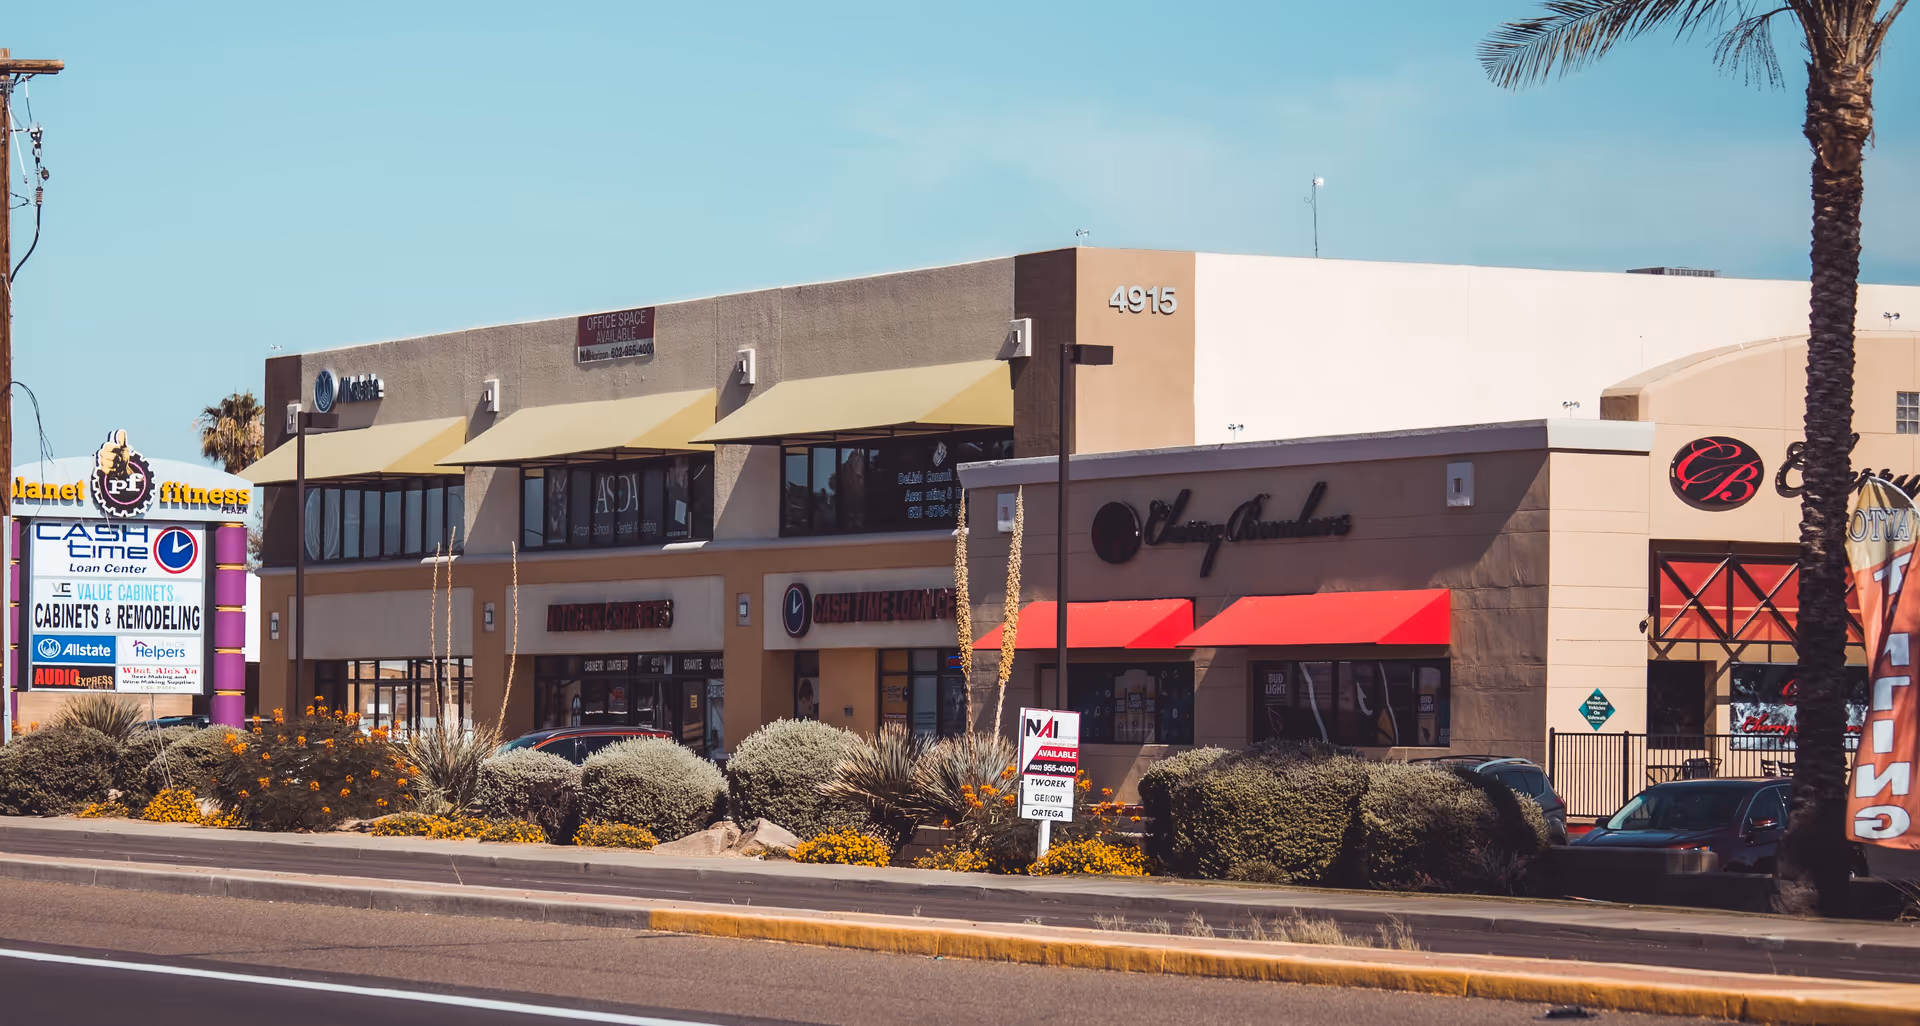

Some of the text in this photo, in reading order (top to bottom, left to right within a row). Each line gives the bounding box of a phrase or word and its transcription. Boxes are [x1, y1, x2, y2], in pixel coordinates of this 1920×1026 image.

[1108, 285, 1178, 316] 4915
[586, 310, 646, 330] OFFICE SPACE
[596, 327, 636, 344] AVAILABLE
[108, 473, 144, 494] pf
[160, 481, 251, 505] fitness
[221, 506, 248, 515] PLAZA
[36, 523, 149, 543] CASH
[67, 540, 148, 560] time
[69, 563, 147, 574] Loan Center
[77, 583, 112, 601] VALUE
[118, 584, 174, 602] CABINETS
[813, 593, 851, 623] CASH
[853, 590, 889, 622] TIME
[34, 603, 200, 631] CABINETS & REMODELING
[62, 643, 111, 657] Allstate
[135, 645, 186, 660] Helpers
[684, 658, 703, 670] GRANITE
[34, 668, 113, 687] AUDIO EXPRESS
[1268, 673, 1284, 684] BUD
[1265, 684, 1287, 695] LIGHT
[1025, 715, 1059, 739] NAI
[1742, 712, 1792, 736] Cherry
[1037, 749, 1077, 759] AVAILABLE
[1043, 764, 1076, 774] 955-4000
[1030, 778, 1067, 788] TWOREK
[1034, 794, 1063, 803] GEROW
[1031, 809, 1064, 818] ORTEGA
